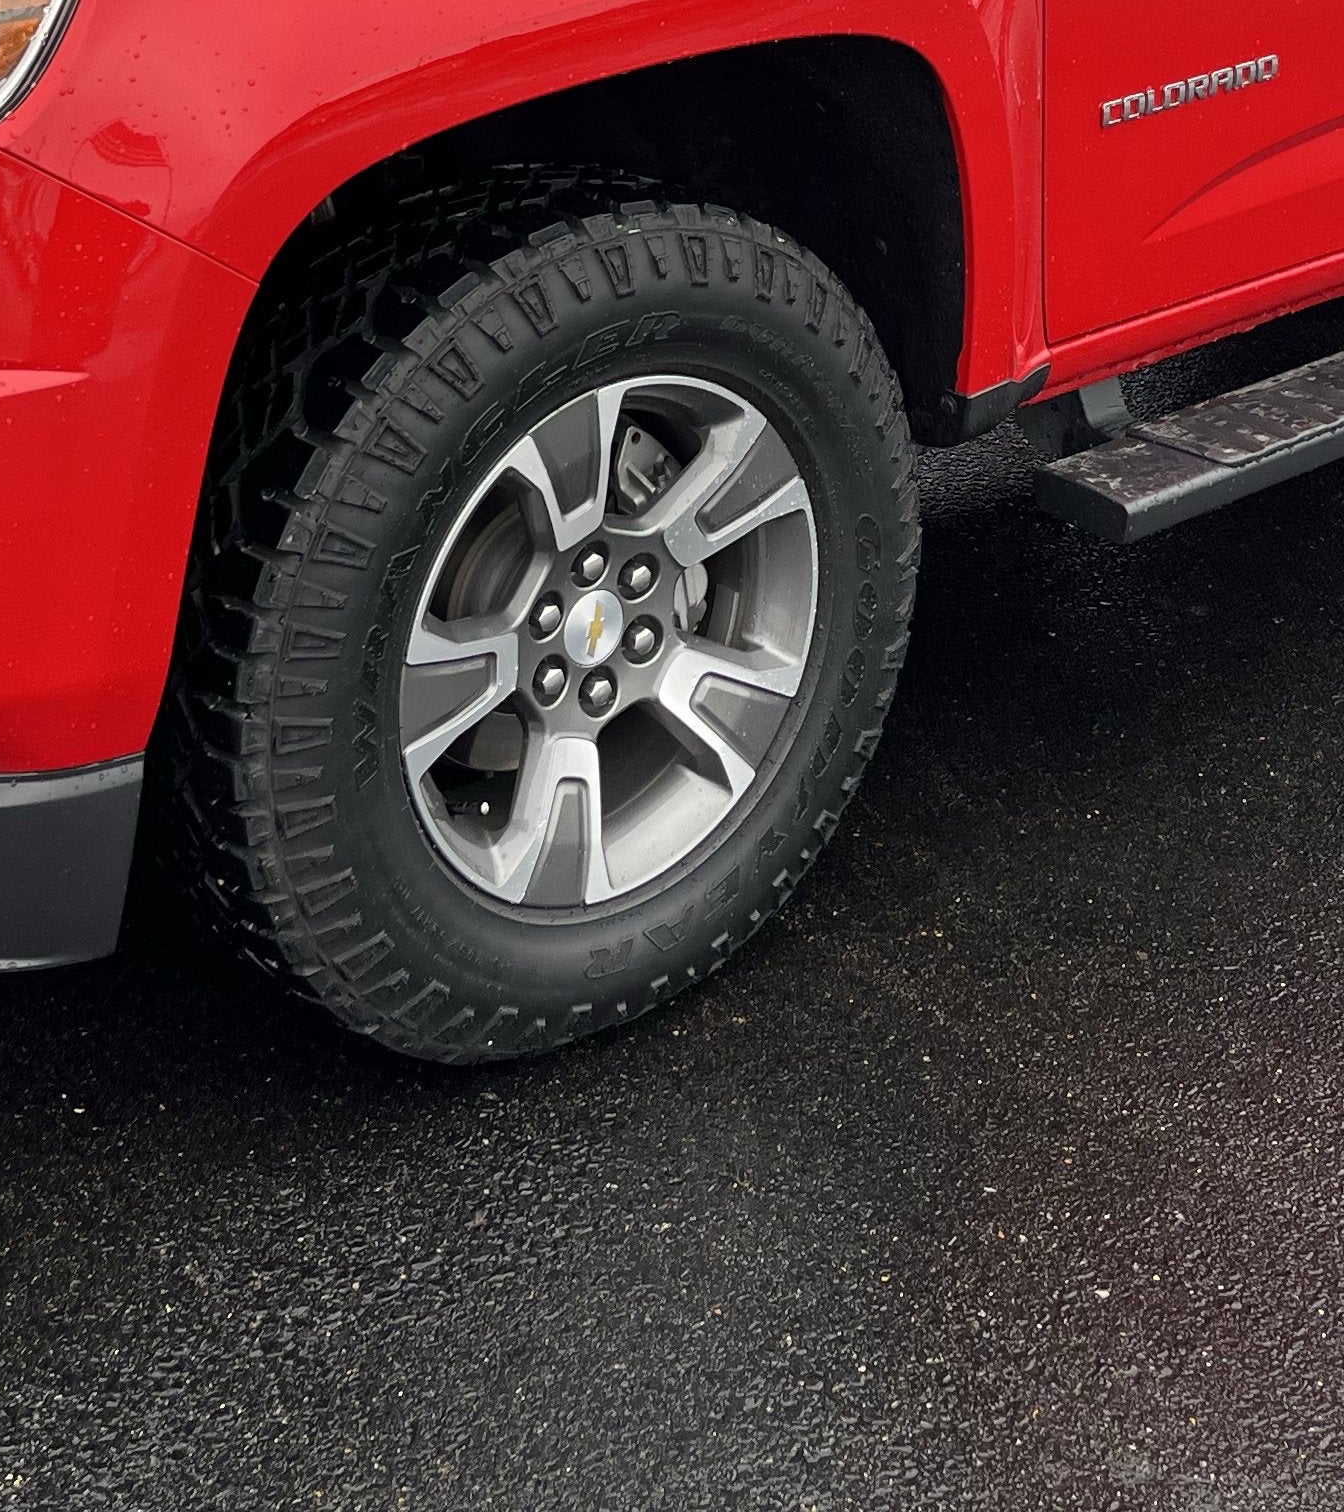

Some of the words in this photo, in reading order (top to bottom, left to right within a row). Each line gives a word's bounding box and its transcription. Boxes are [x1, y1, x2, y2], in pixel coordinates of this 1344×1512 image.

[1099, 54, 1280, 128] COLORADO
[351, 310, 682, 790] WRANGLER
[585, 513, 882, 980] GOODYEAR
